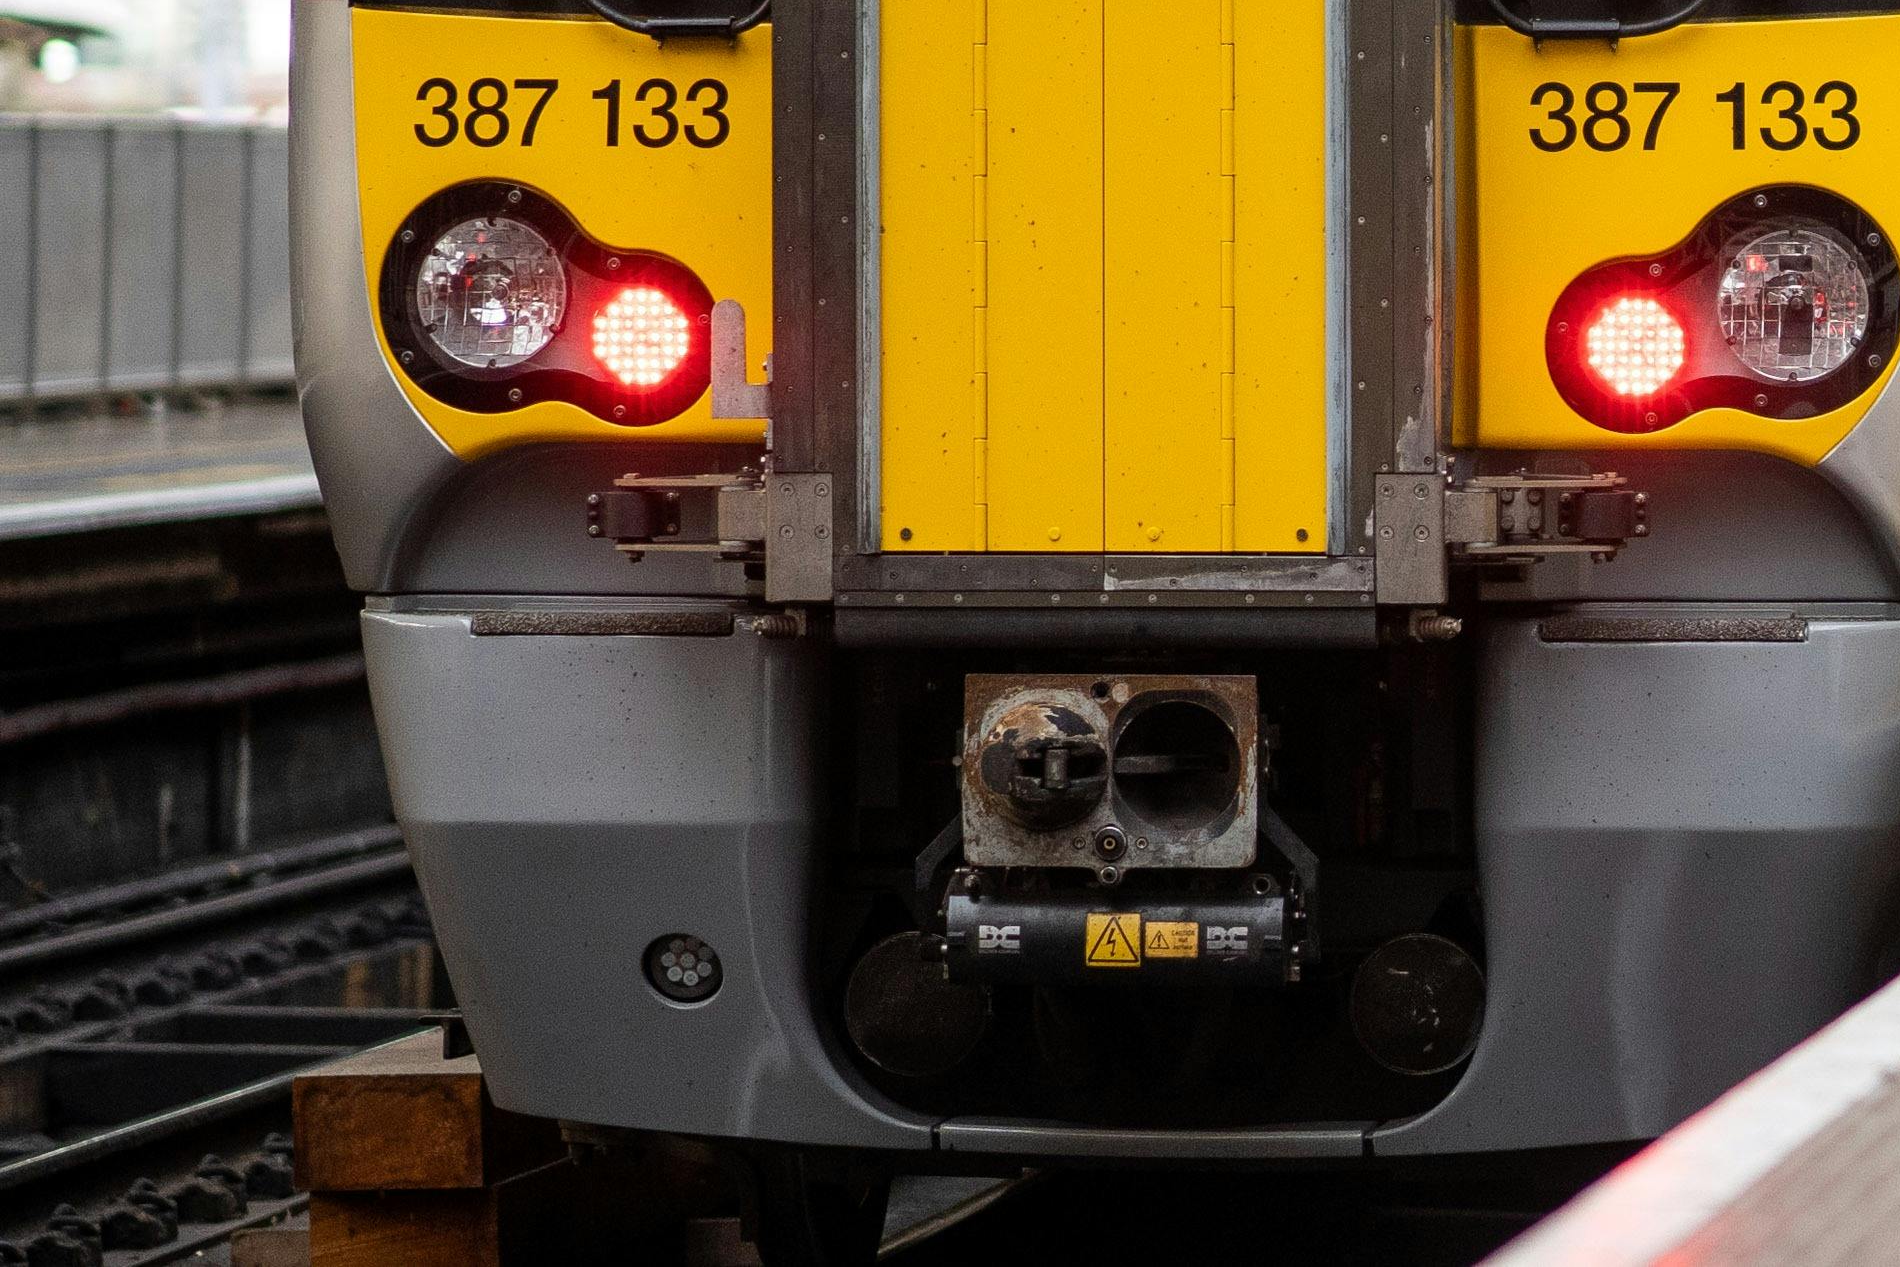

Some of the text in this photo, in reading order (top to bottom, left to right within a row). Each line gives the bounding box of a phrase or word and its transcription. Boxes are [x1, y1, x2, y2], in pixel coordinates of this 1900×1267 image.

[413, 77, 731, 149] 387 133
[1529, 80, 1861, 152] 387 133
